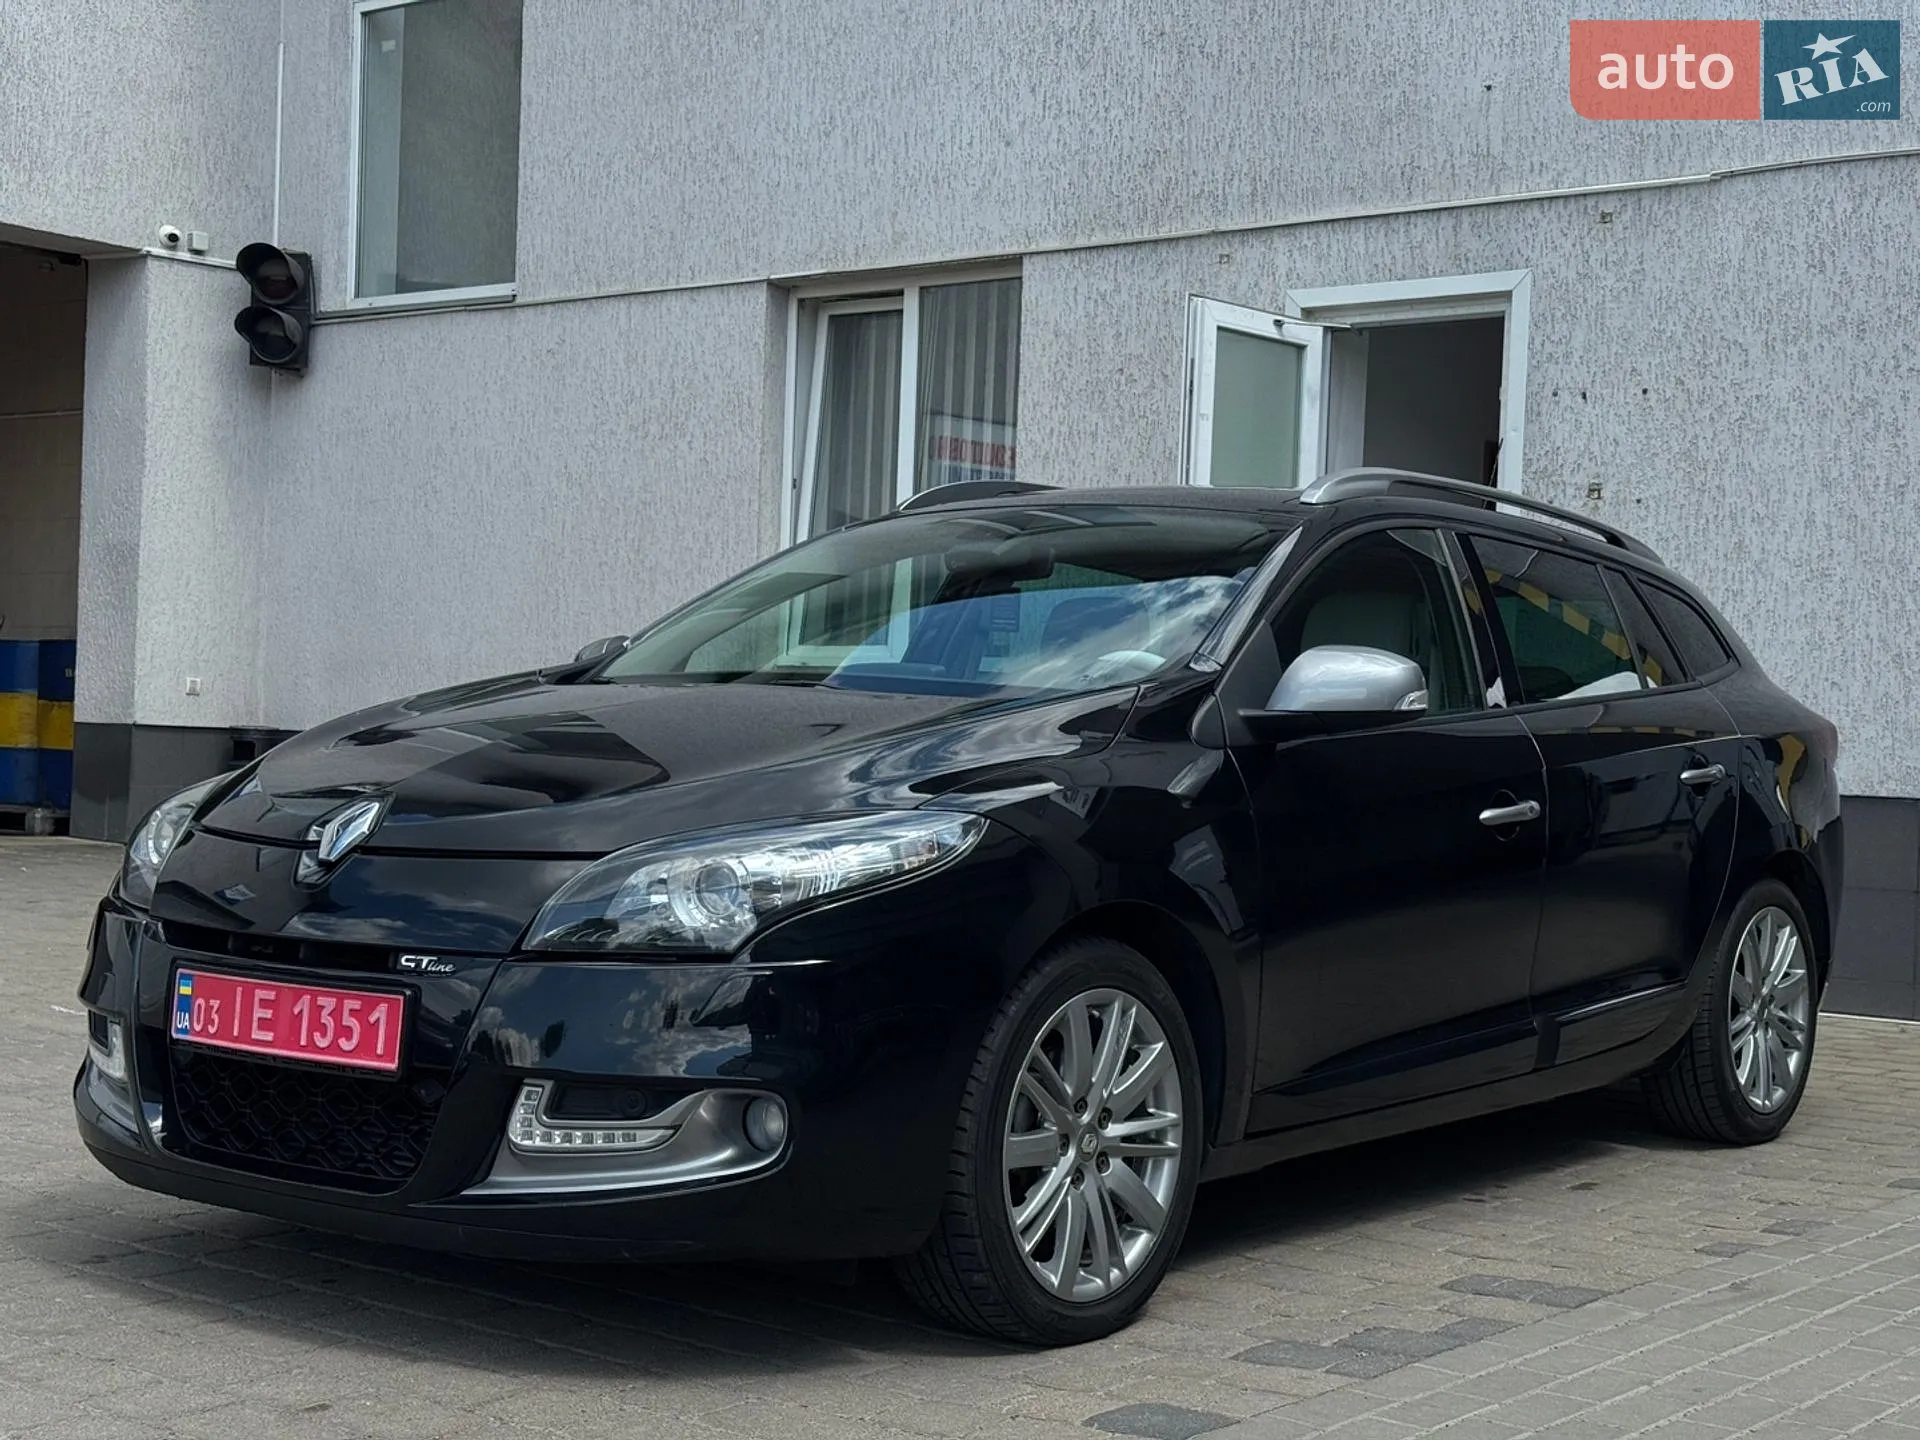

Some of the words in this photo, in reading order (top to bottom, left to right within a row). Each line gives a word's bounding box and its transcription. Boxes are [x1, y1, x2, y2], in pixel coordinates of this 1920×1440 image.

[176, 1010, 190, 1030] UA
[193, 998, 220, 1034] 03
[233, 986, 277, 1042] IE
[293, 994, 389, 1056] 1351
